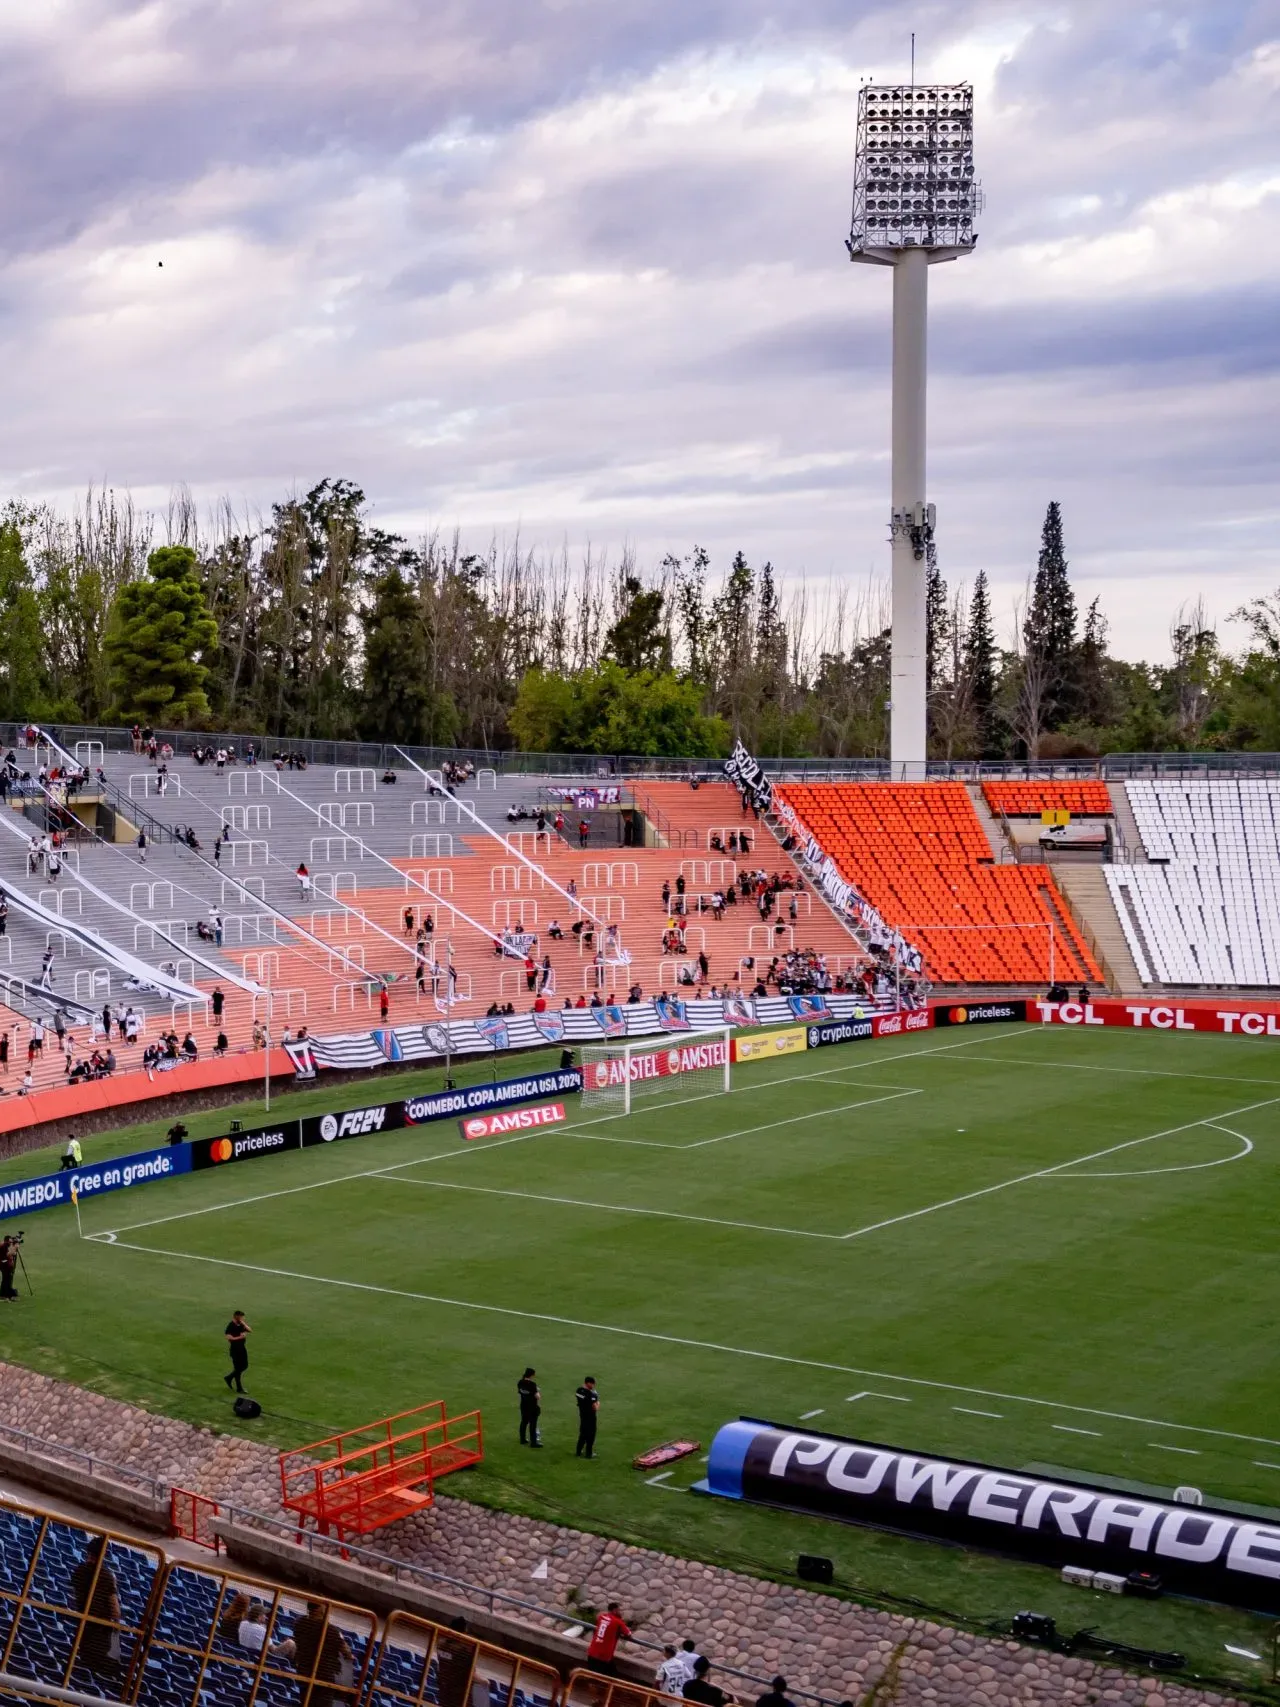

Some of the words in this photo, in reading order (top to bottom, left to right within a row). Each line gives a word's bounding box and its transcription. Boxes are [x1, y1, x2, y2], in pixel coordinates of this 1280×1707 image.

[579, 798, 594, 808] PN
[969, 1006, 1010, 1021] priceless
[1036, 1003, 1104, 1024] TCL
[1126, 1007, 1195, 1029] TCL
[1217, 1012, 1280, 1035] TCL
[821, 1023, 872, 1042] crypto.com
[409, 1098, 467, 1119] CONMEBOL
[468, 1089, 495, 1107] COPA
[495, 1081, 539, 1102] AMERICA
[540, 1077, 558, 1092] USA
[559, 1073, 580, 1089] 2024
[490, 1106, 564, 1132] AMSTEL
[234, 1132, 284, 1156] priceless
[70, 1174, 101, 1194] Cree
[104, 1170, 120, 1186] en
[769, 1435, 1280, 1580] POWERADE
